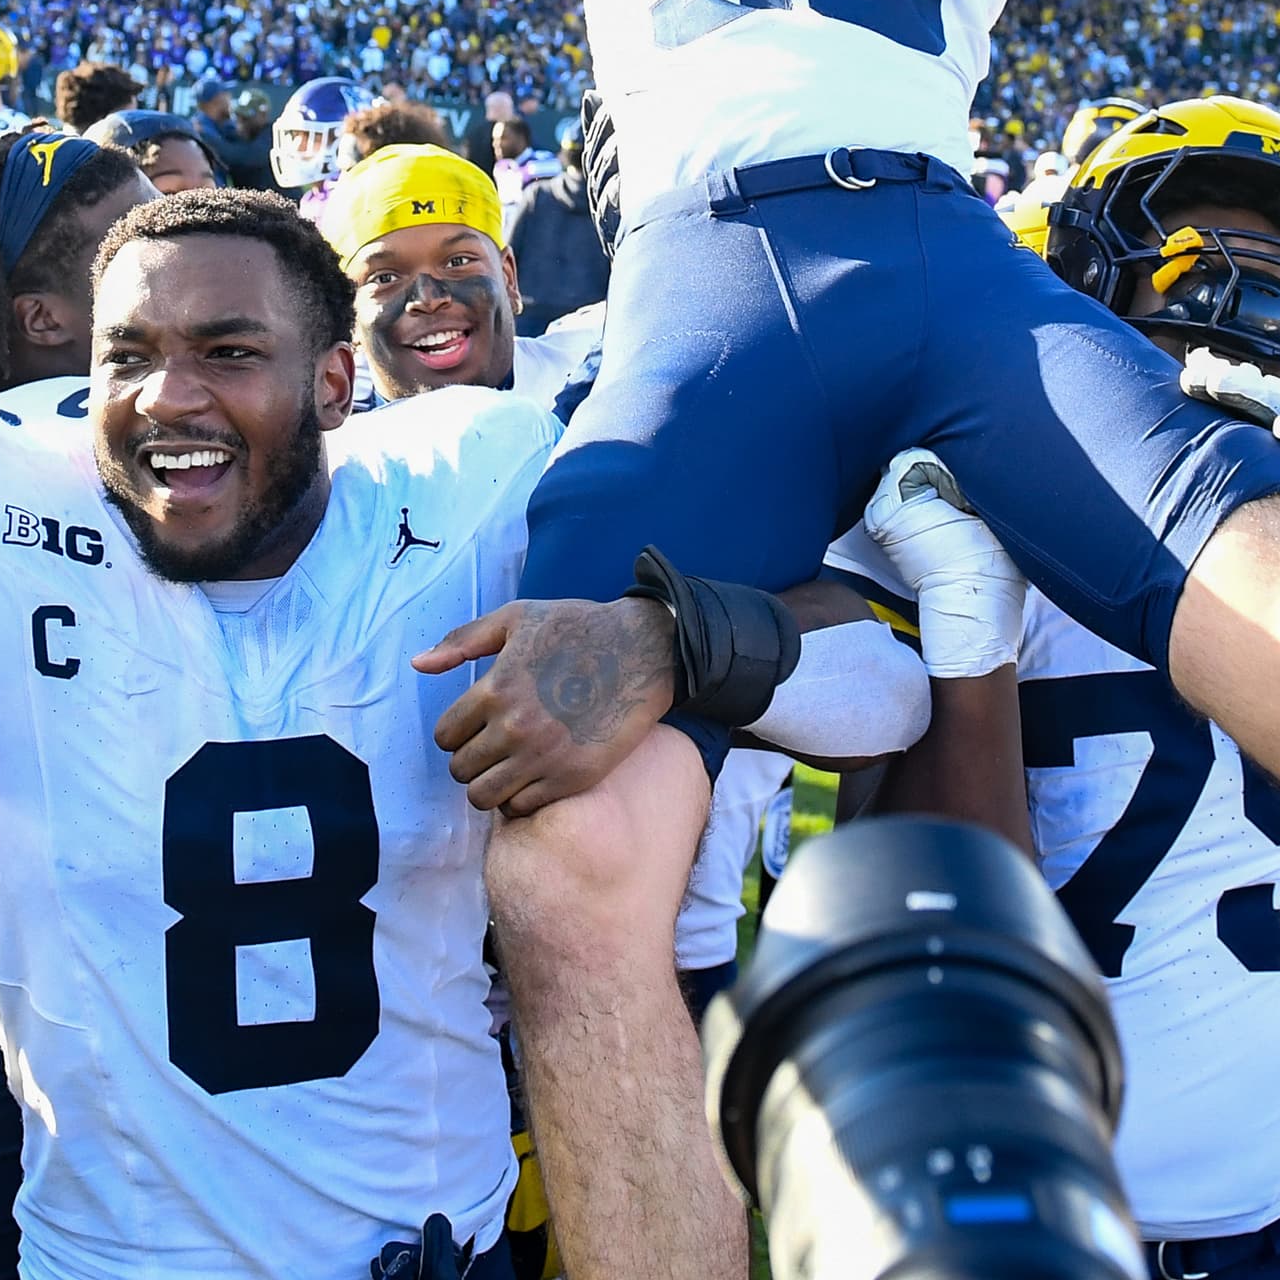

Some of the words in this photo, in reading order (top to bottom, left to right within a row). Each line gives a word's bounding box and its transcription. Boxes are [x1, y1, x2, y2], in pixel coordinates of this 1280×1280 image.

[412, 200, 436, 214] M
[31, 604, 82, 680] C
[162, 733, 382, 1096] 8
